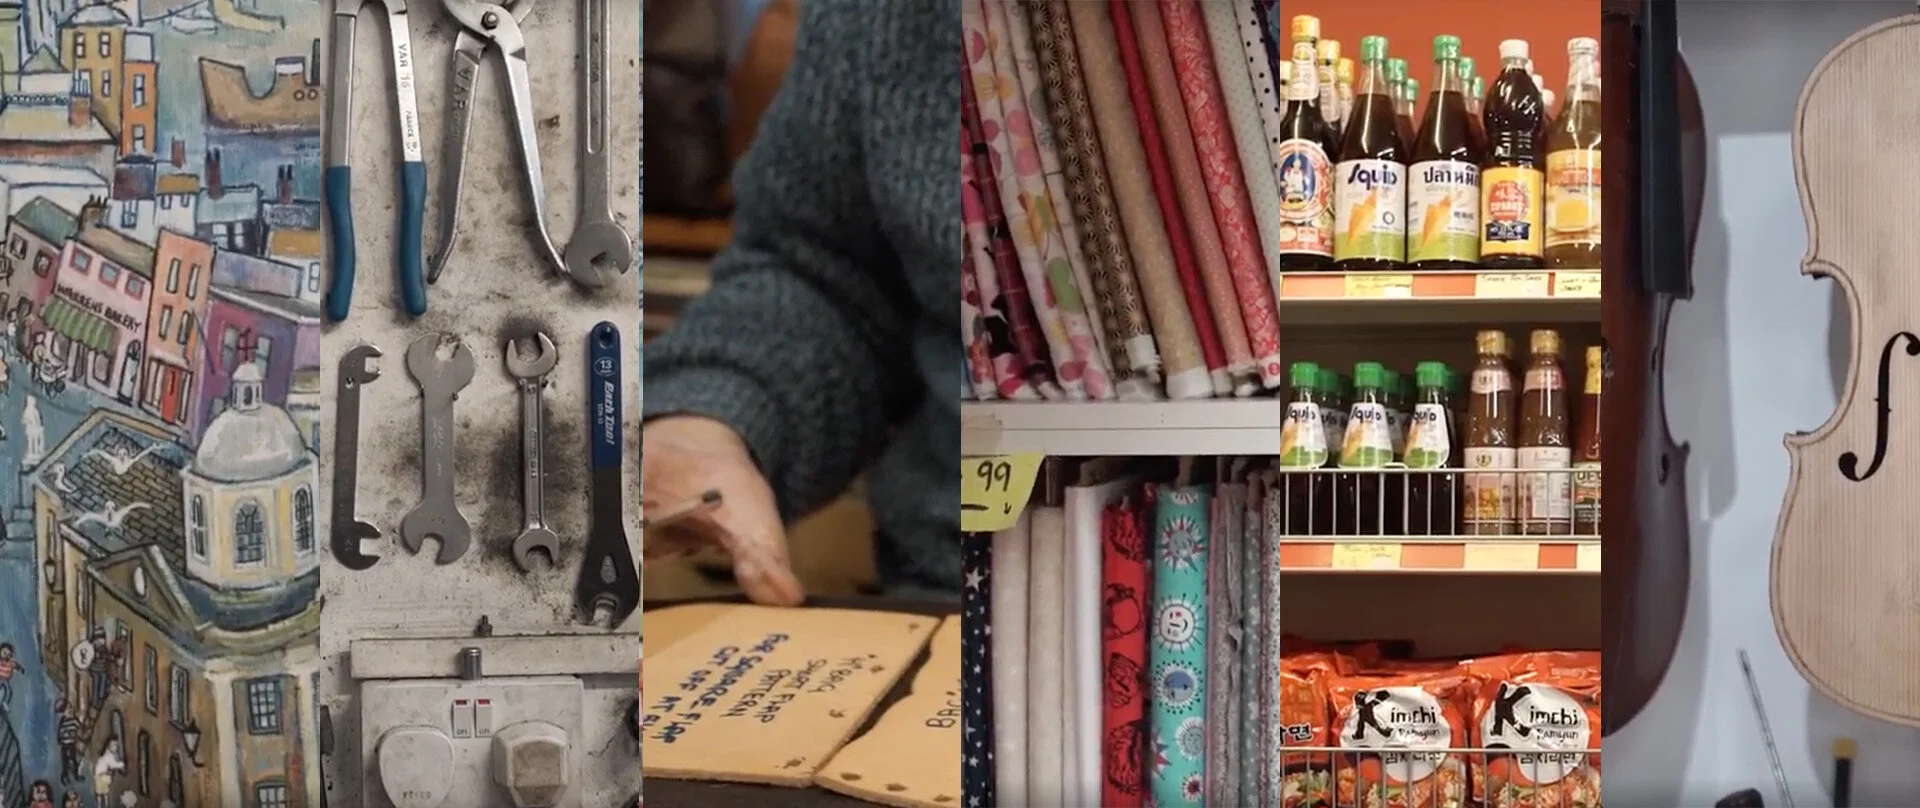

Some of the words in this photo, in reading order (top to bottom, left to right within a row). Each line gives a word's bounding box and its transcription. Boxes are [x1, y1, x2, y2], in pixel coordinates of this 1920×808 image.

[398, 43, 410, 68] VAR
[104, 306, 142, 333] BAKERY
[600, 359, 612, 369] 13
[605, 415, 616, 445] Tool
[977, 460, 1011, 492] 99
[719, 669, 792, 718] PATTERN
[753, 694, 796, 724] FLAP
[1490, 683, 1579, 738] Kimchi
[456, 728, 468, 736] on
[479, 728, 491, 736] on
[1280, 726, 1312, 743] 면
